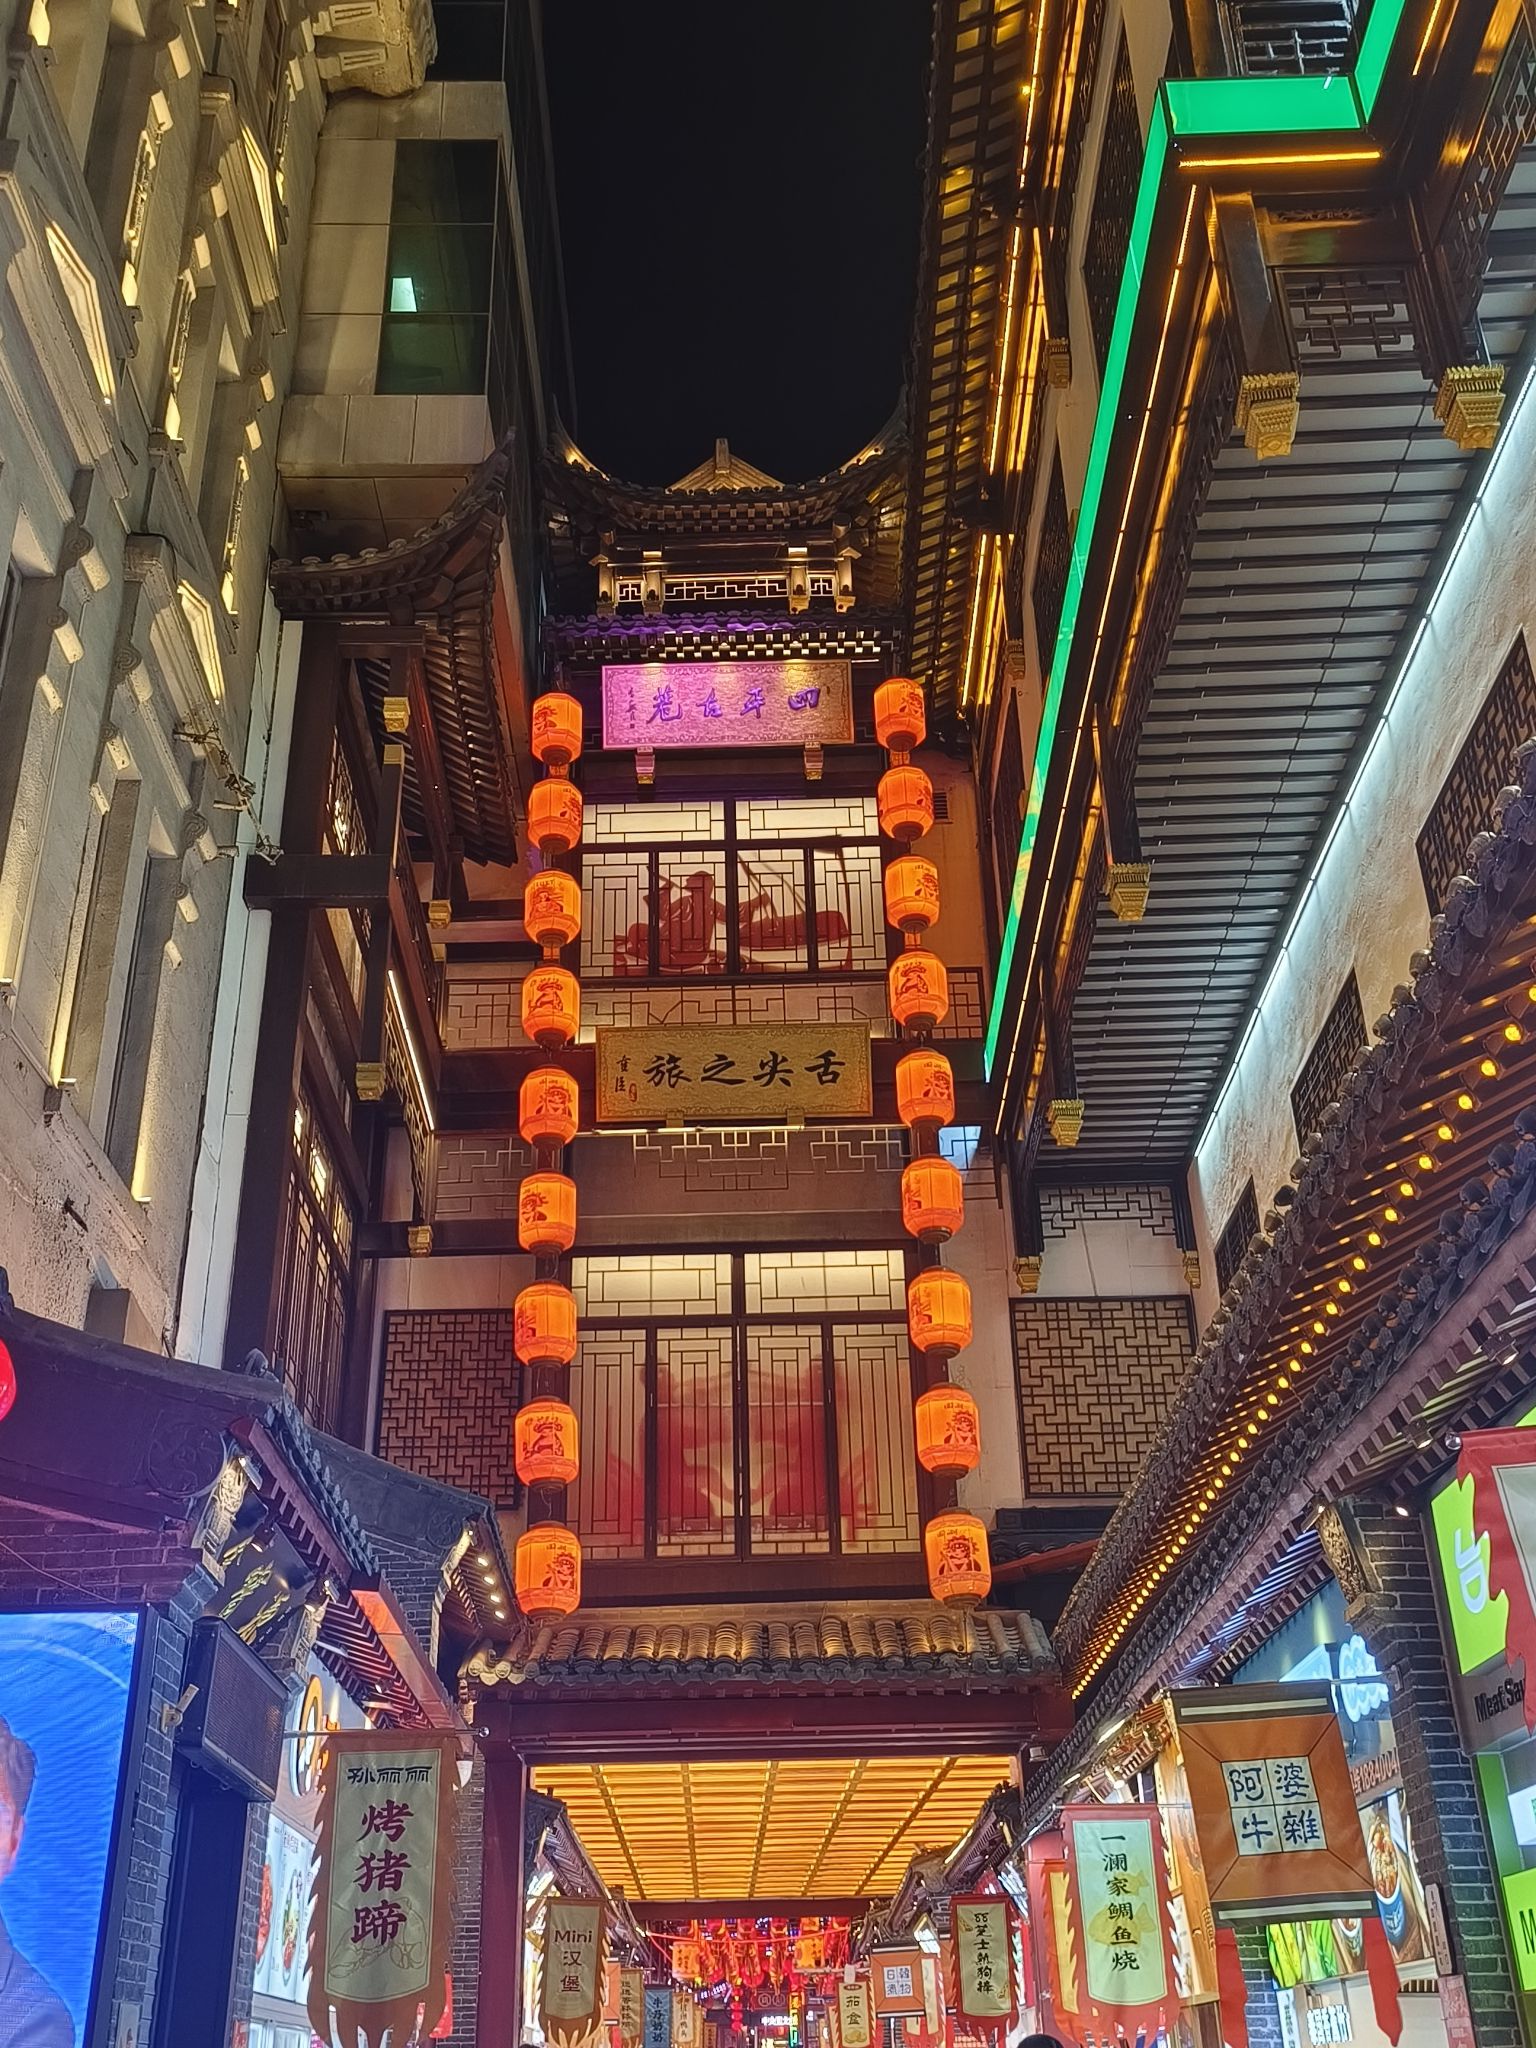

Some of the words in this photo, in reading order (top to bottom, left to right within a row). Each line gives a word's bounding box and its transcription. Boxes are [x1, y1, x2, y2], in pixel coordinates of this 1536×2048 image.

[642, 1050, 846, 1089] 舌尖之旅
[347, 1766, 433, 1785] 孙丽丽
[1229, 1762, 1310, 1802] 阿婆
[351, 1799, 415, 1946] 烤猪蹄
[1100, 1834, 1140, 1973] 一澜家鲷鱼烧
[554, 1929, 593, 1943] Mini
[560, 1950, 583, 1993] 汉堡
